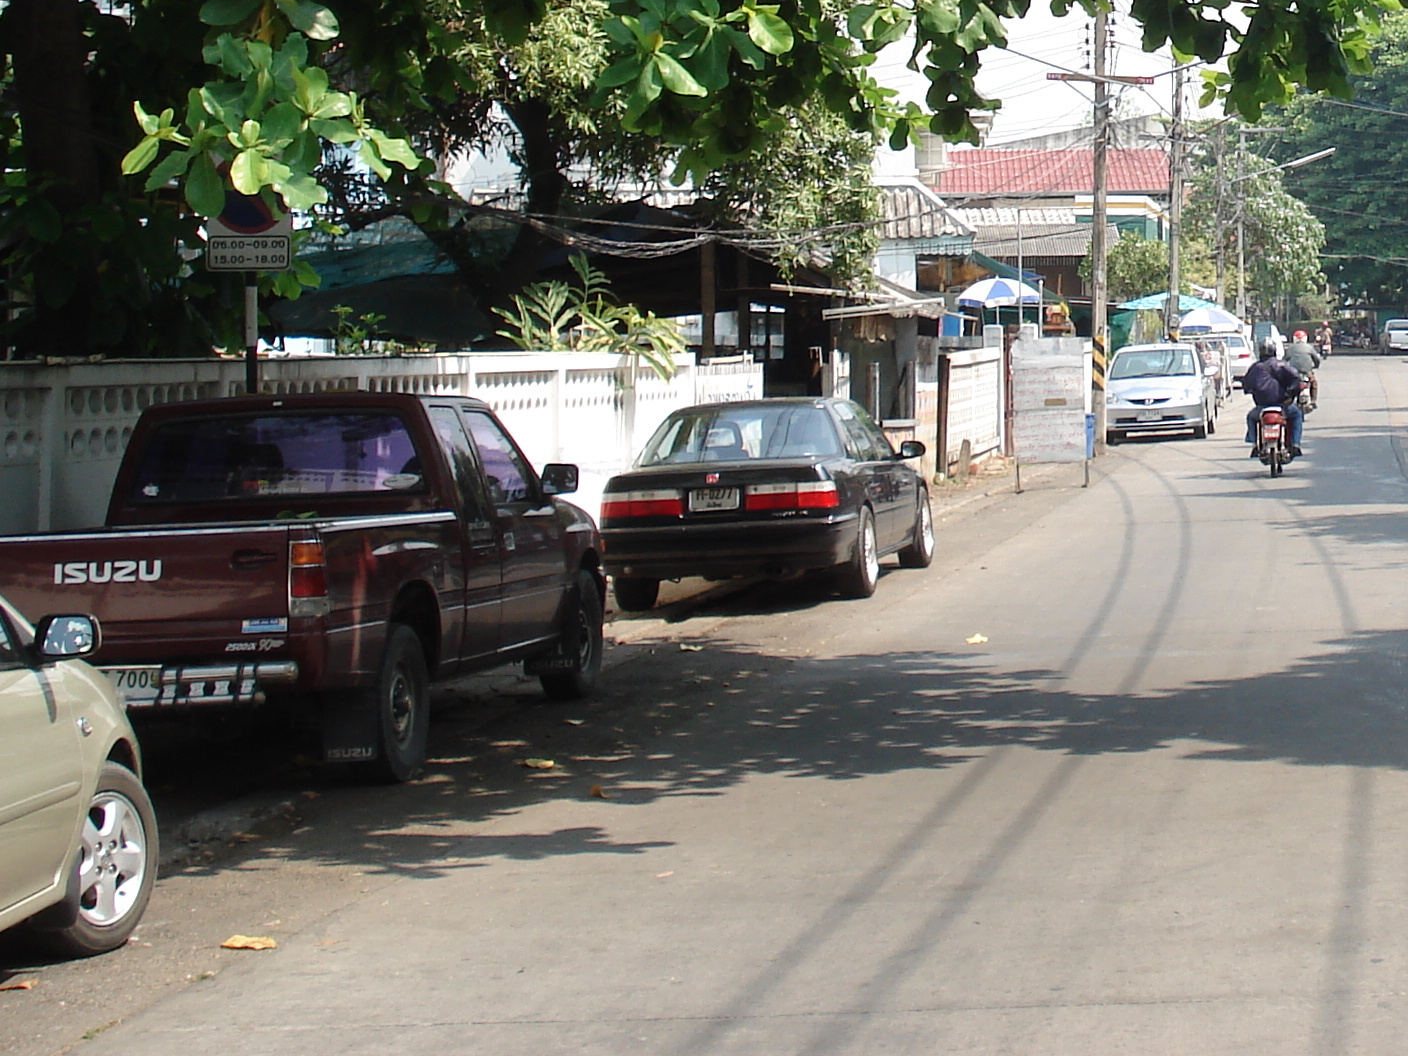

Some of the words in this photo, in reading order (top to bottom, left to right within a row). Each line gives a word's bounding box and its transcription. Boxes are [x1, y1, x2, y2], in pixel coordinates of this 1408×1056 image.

[212, 240, 286, 250] 06.00-09.00
[214, 255, 286, 264] 15.00-18.00
[54, 559, 162, 585] ISUZU
[327, 747, 373, 759] ISUZU
